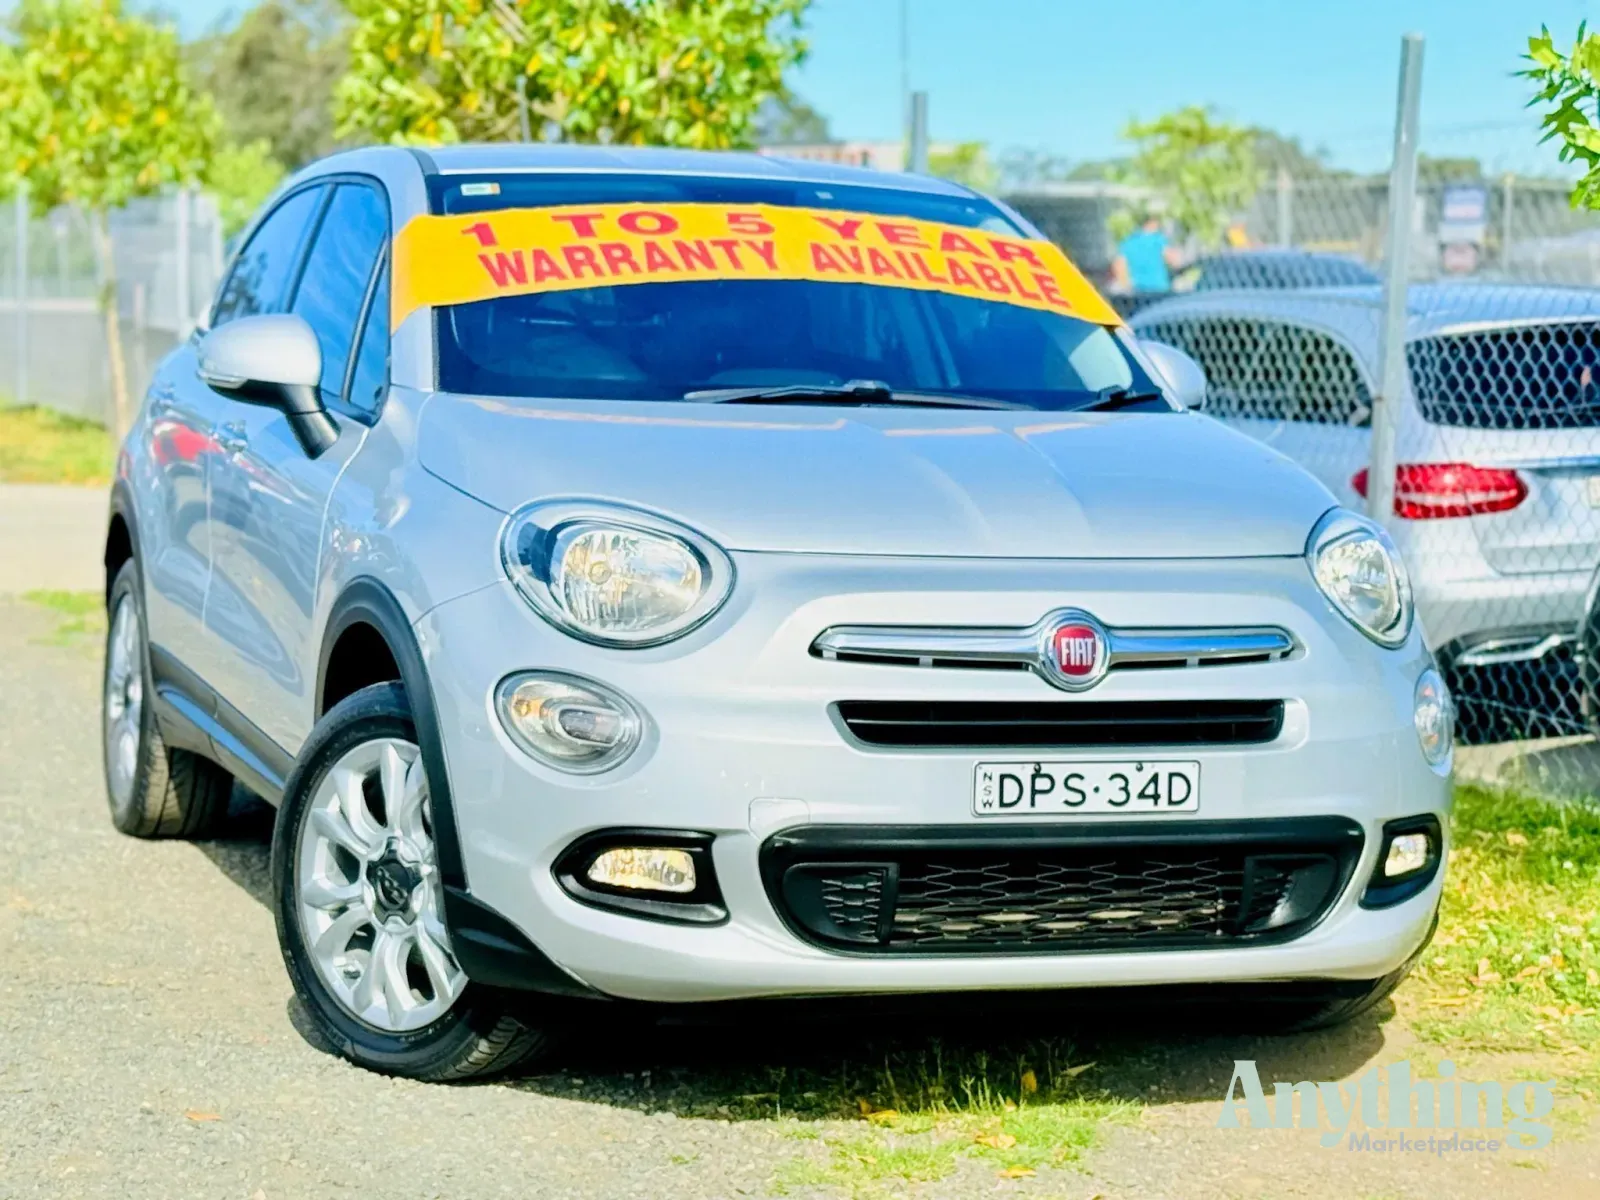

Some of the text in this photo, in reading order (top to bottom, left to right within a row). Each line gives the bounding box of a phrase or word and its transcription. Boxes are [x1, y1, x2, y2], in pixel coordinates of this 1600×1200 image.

[461, 211, 1044, 268] 1 TO 5 YEAR
[478, 238, 1068, 308] WARRANTY AVAILABLE
[1060, 636, 1095, 667] FIAT
